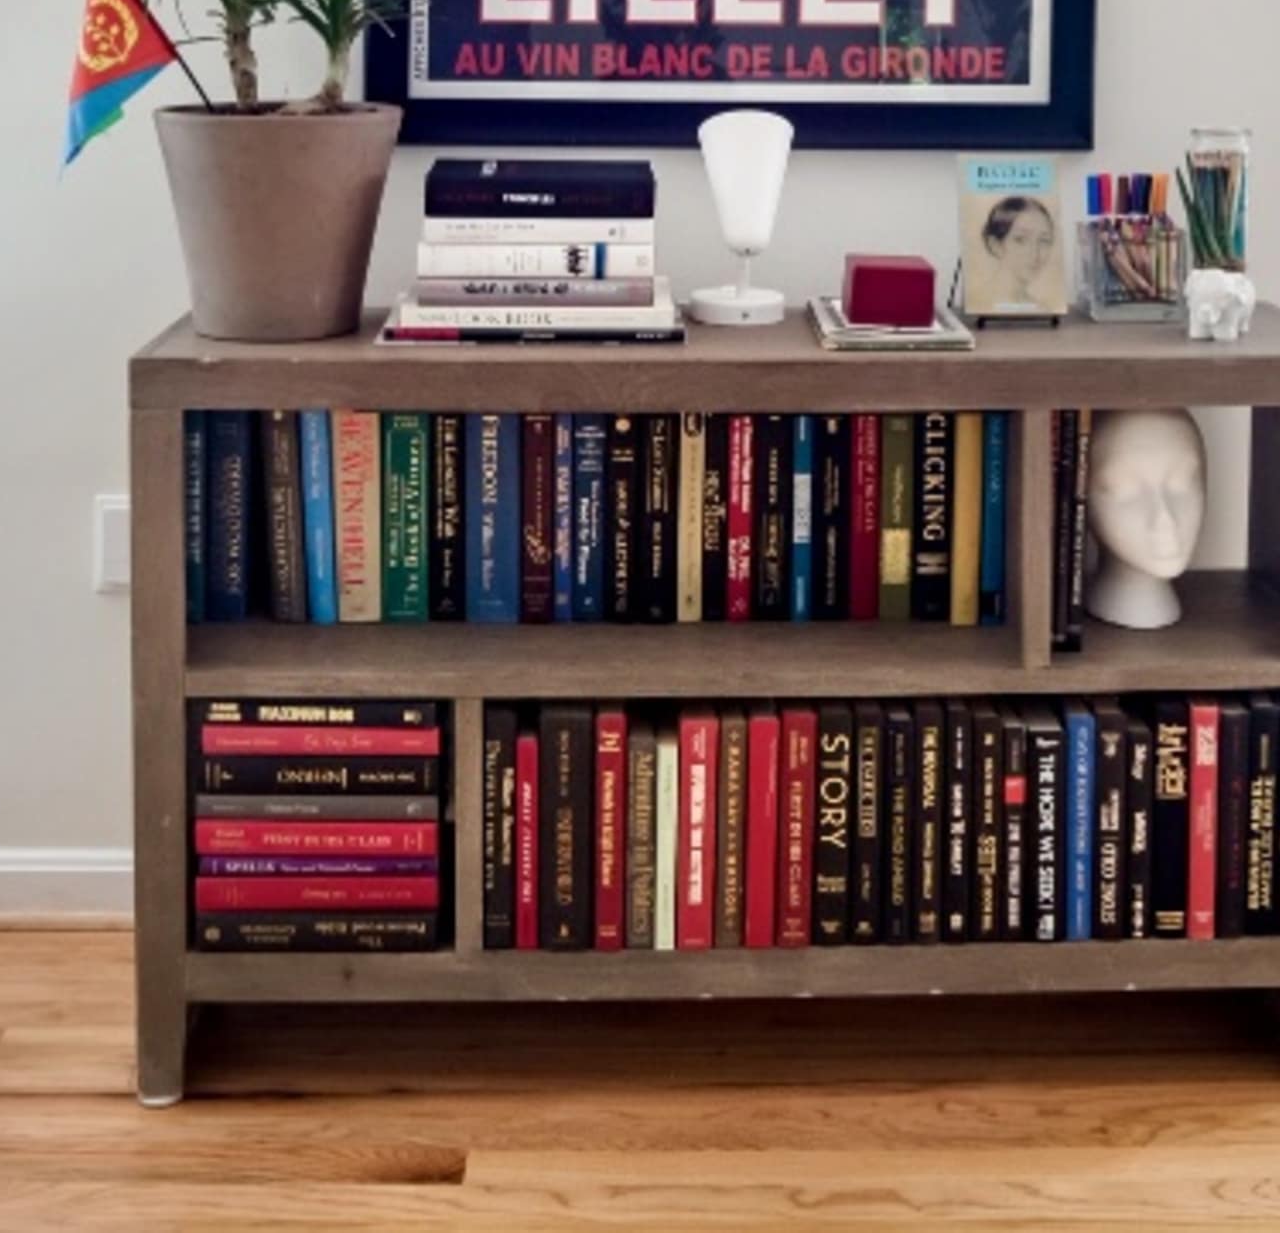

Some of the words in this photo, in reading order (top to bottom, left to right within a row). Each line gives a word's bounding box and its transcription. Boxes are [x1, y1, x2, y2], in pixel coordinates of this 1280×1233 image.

[455, 43, 504, 75] AU
[518, 44, 582, 77] VIN
[593, 44, 713, 77] BLANC
[726, 46, 771, 77] DE
[786, 46, 828, 77] LA
[841, 46, 1004, 79] GIRONDE
[482, 415, 500, 505] FREEDOM
[922, 413, 947, 542] CLICKING
[922, 726, 938, 749] THE
[1038, 754, 1056, 783] THE
[820, 733, 849, 849] STORY
[1038, 787, 1056, 831] HOPE
[1038, 835, 1056, 862] WE
[1038, 865, 1056, 904] SEEK
